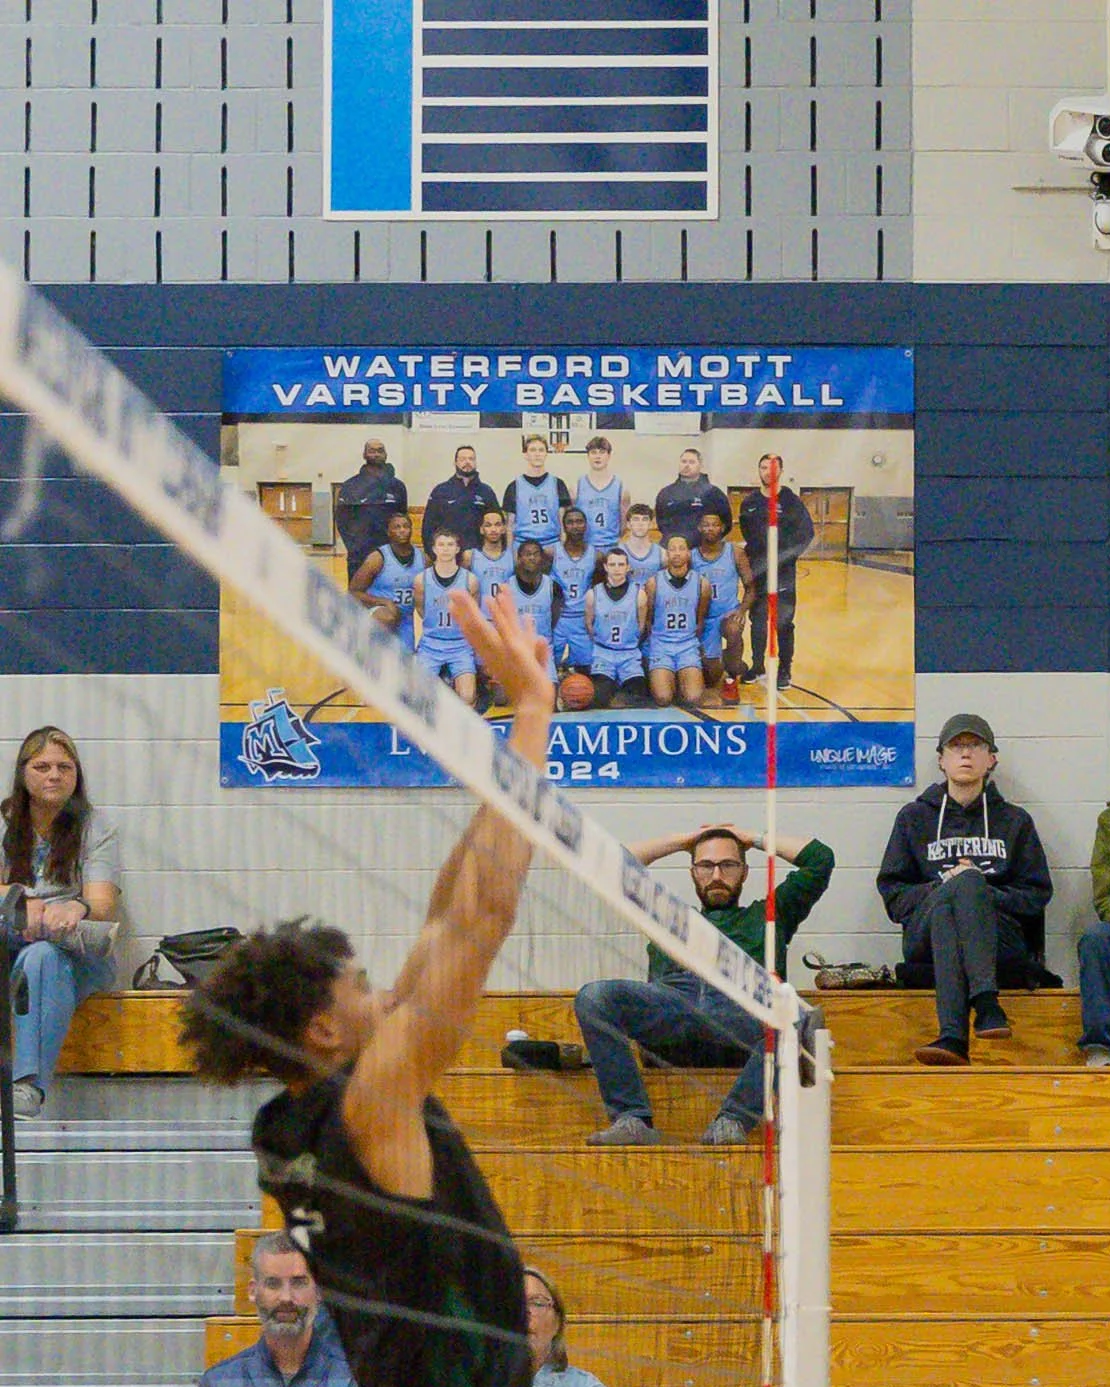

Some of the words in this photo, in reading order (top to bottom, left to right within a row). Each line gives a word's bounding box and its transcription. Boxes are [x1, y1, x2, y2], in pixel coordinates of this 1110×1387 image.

[323, 354, 631, 379] WATERFORD
[656, 354, 793, 379] MOTT
[272, 382, 490, 407] VARSITY
[515, 382, 844, 407] BASKETBALL
[531, 509, 549, 524] 35
[595, 512, 605, 527] 4
[395, 590, 412, 604] 32
[569, 583, 578, 598] 5
[667, 613, 687, 629] 22
[612, 626, 621, 642] 2
[927, 836, 1007, 861] KETTERING
